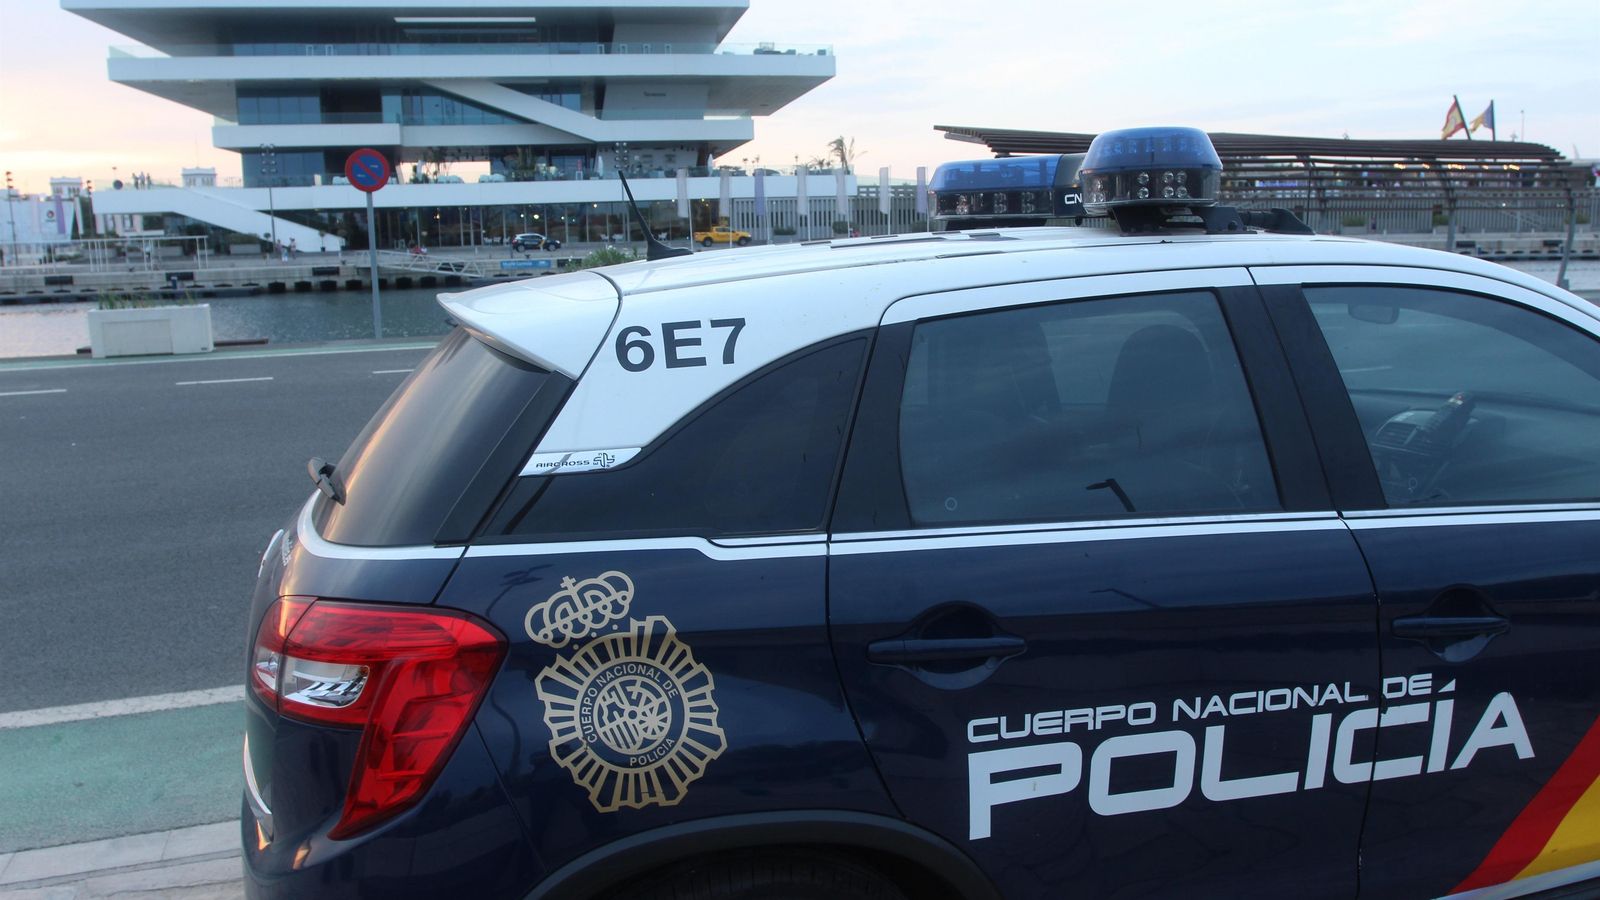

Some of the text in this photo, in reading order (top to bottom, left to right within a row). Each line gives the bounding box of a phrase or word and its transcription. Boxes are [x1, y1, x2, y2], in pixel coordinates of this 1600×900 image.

[615, 317, 746, 372] 6E7
[535, 459, 590, 468] AIRCROSS
[581, 663, 678, 743] CUERPO NACIONAL DE
[967, 673, 1432, 743] CUERPO NACIONAL DE
[629, 738, 675, 766] POLICIA
[967, 679, 1535, 840] POLICÍA
